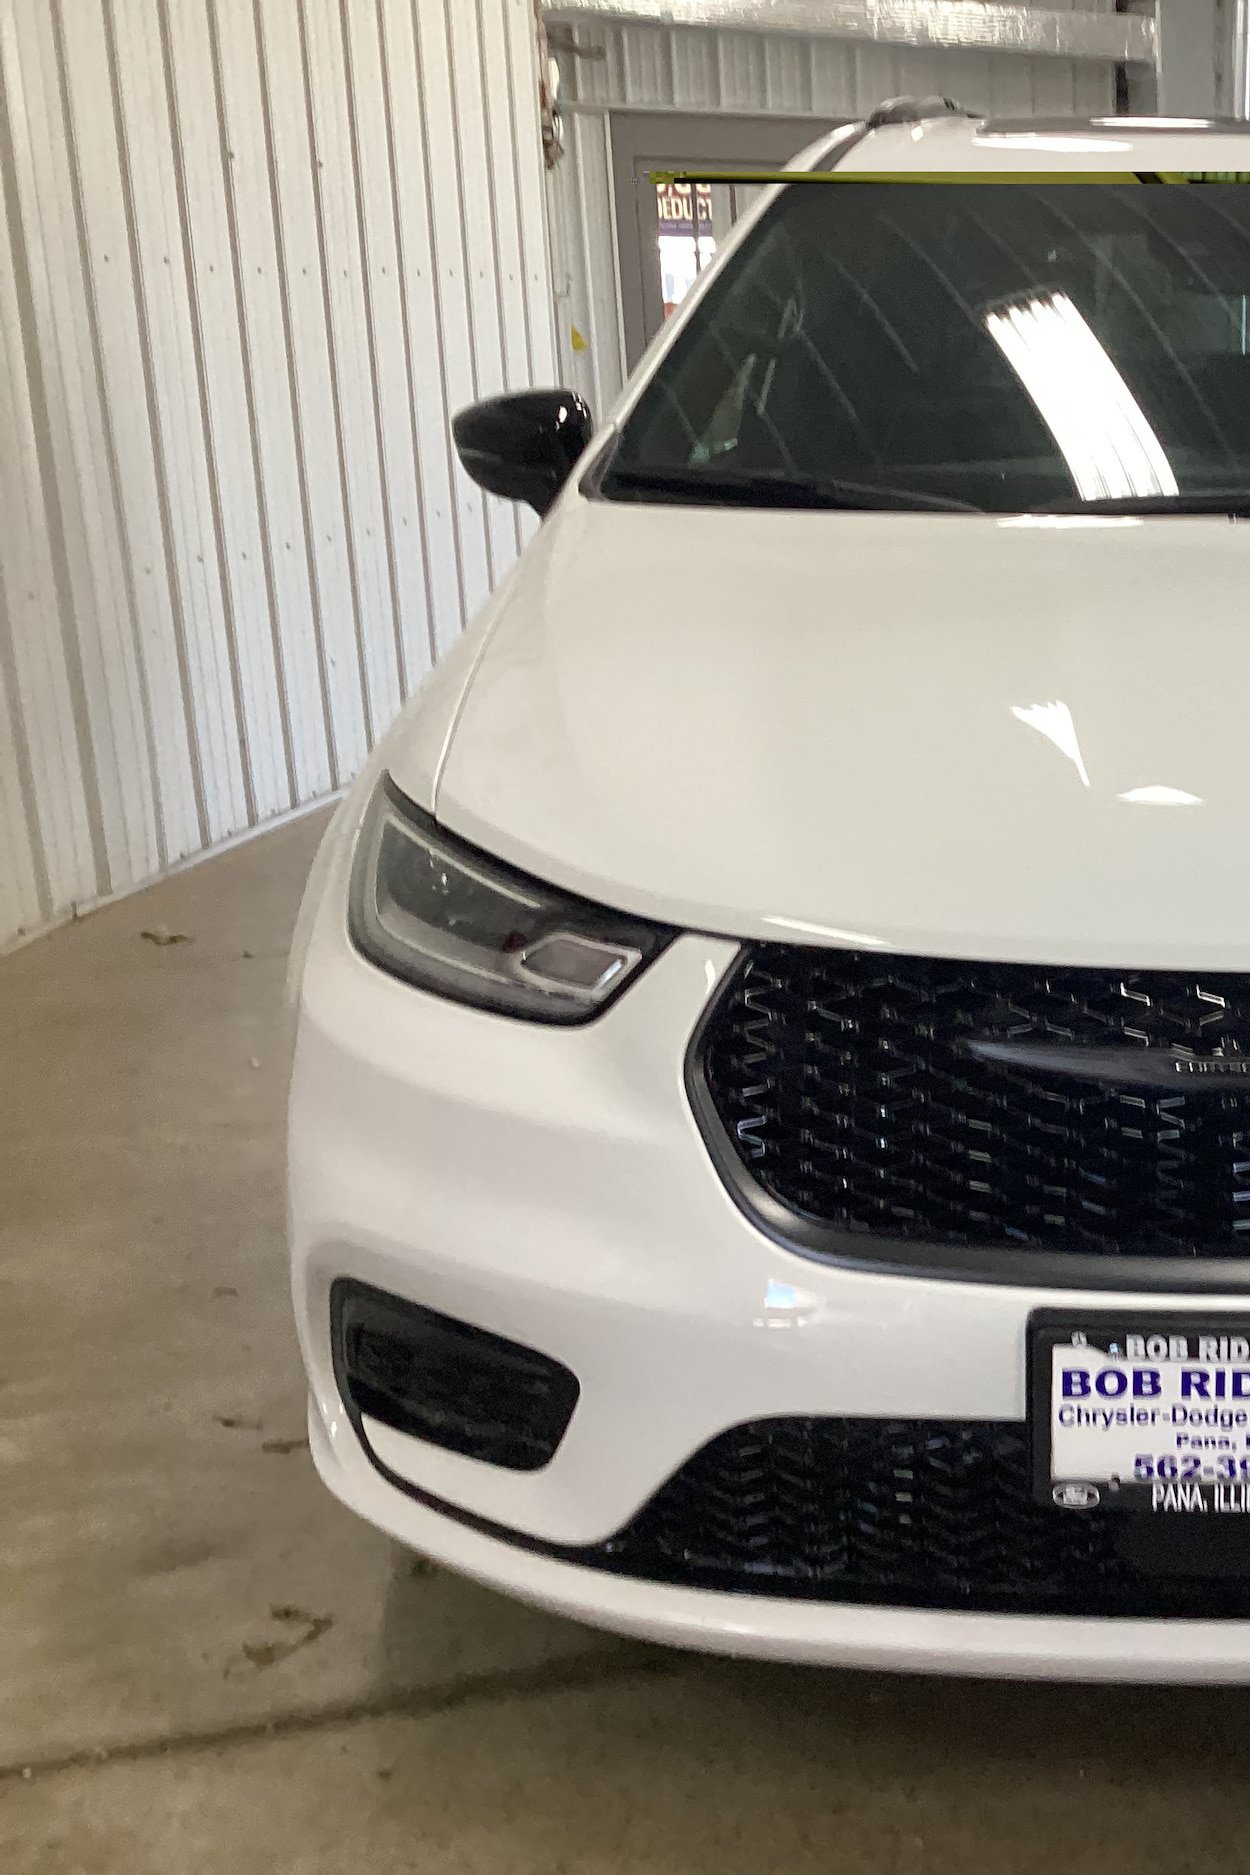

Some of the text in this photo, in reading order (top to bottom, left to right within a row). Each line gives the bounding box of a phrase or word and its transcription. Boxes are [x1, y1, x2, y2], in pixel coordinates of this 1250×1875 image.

[1126, 1335, 1188, 1363] BOB
[1062, 1367, 1162, 1401] BOB
[1176, 1431, 1236, 1452] Pana,
